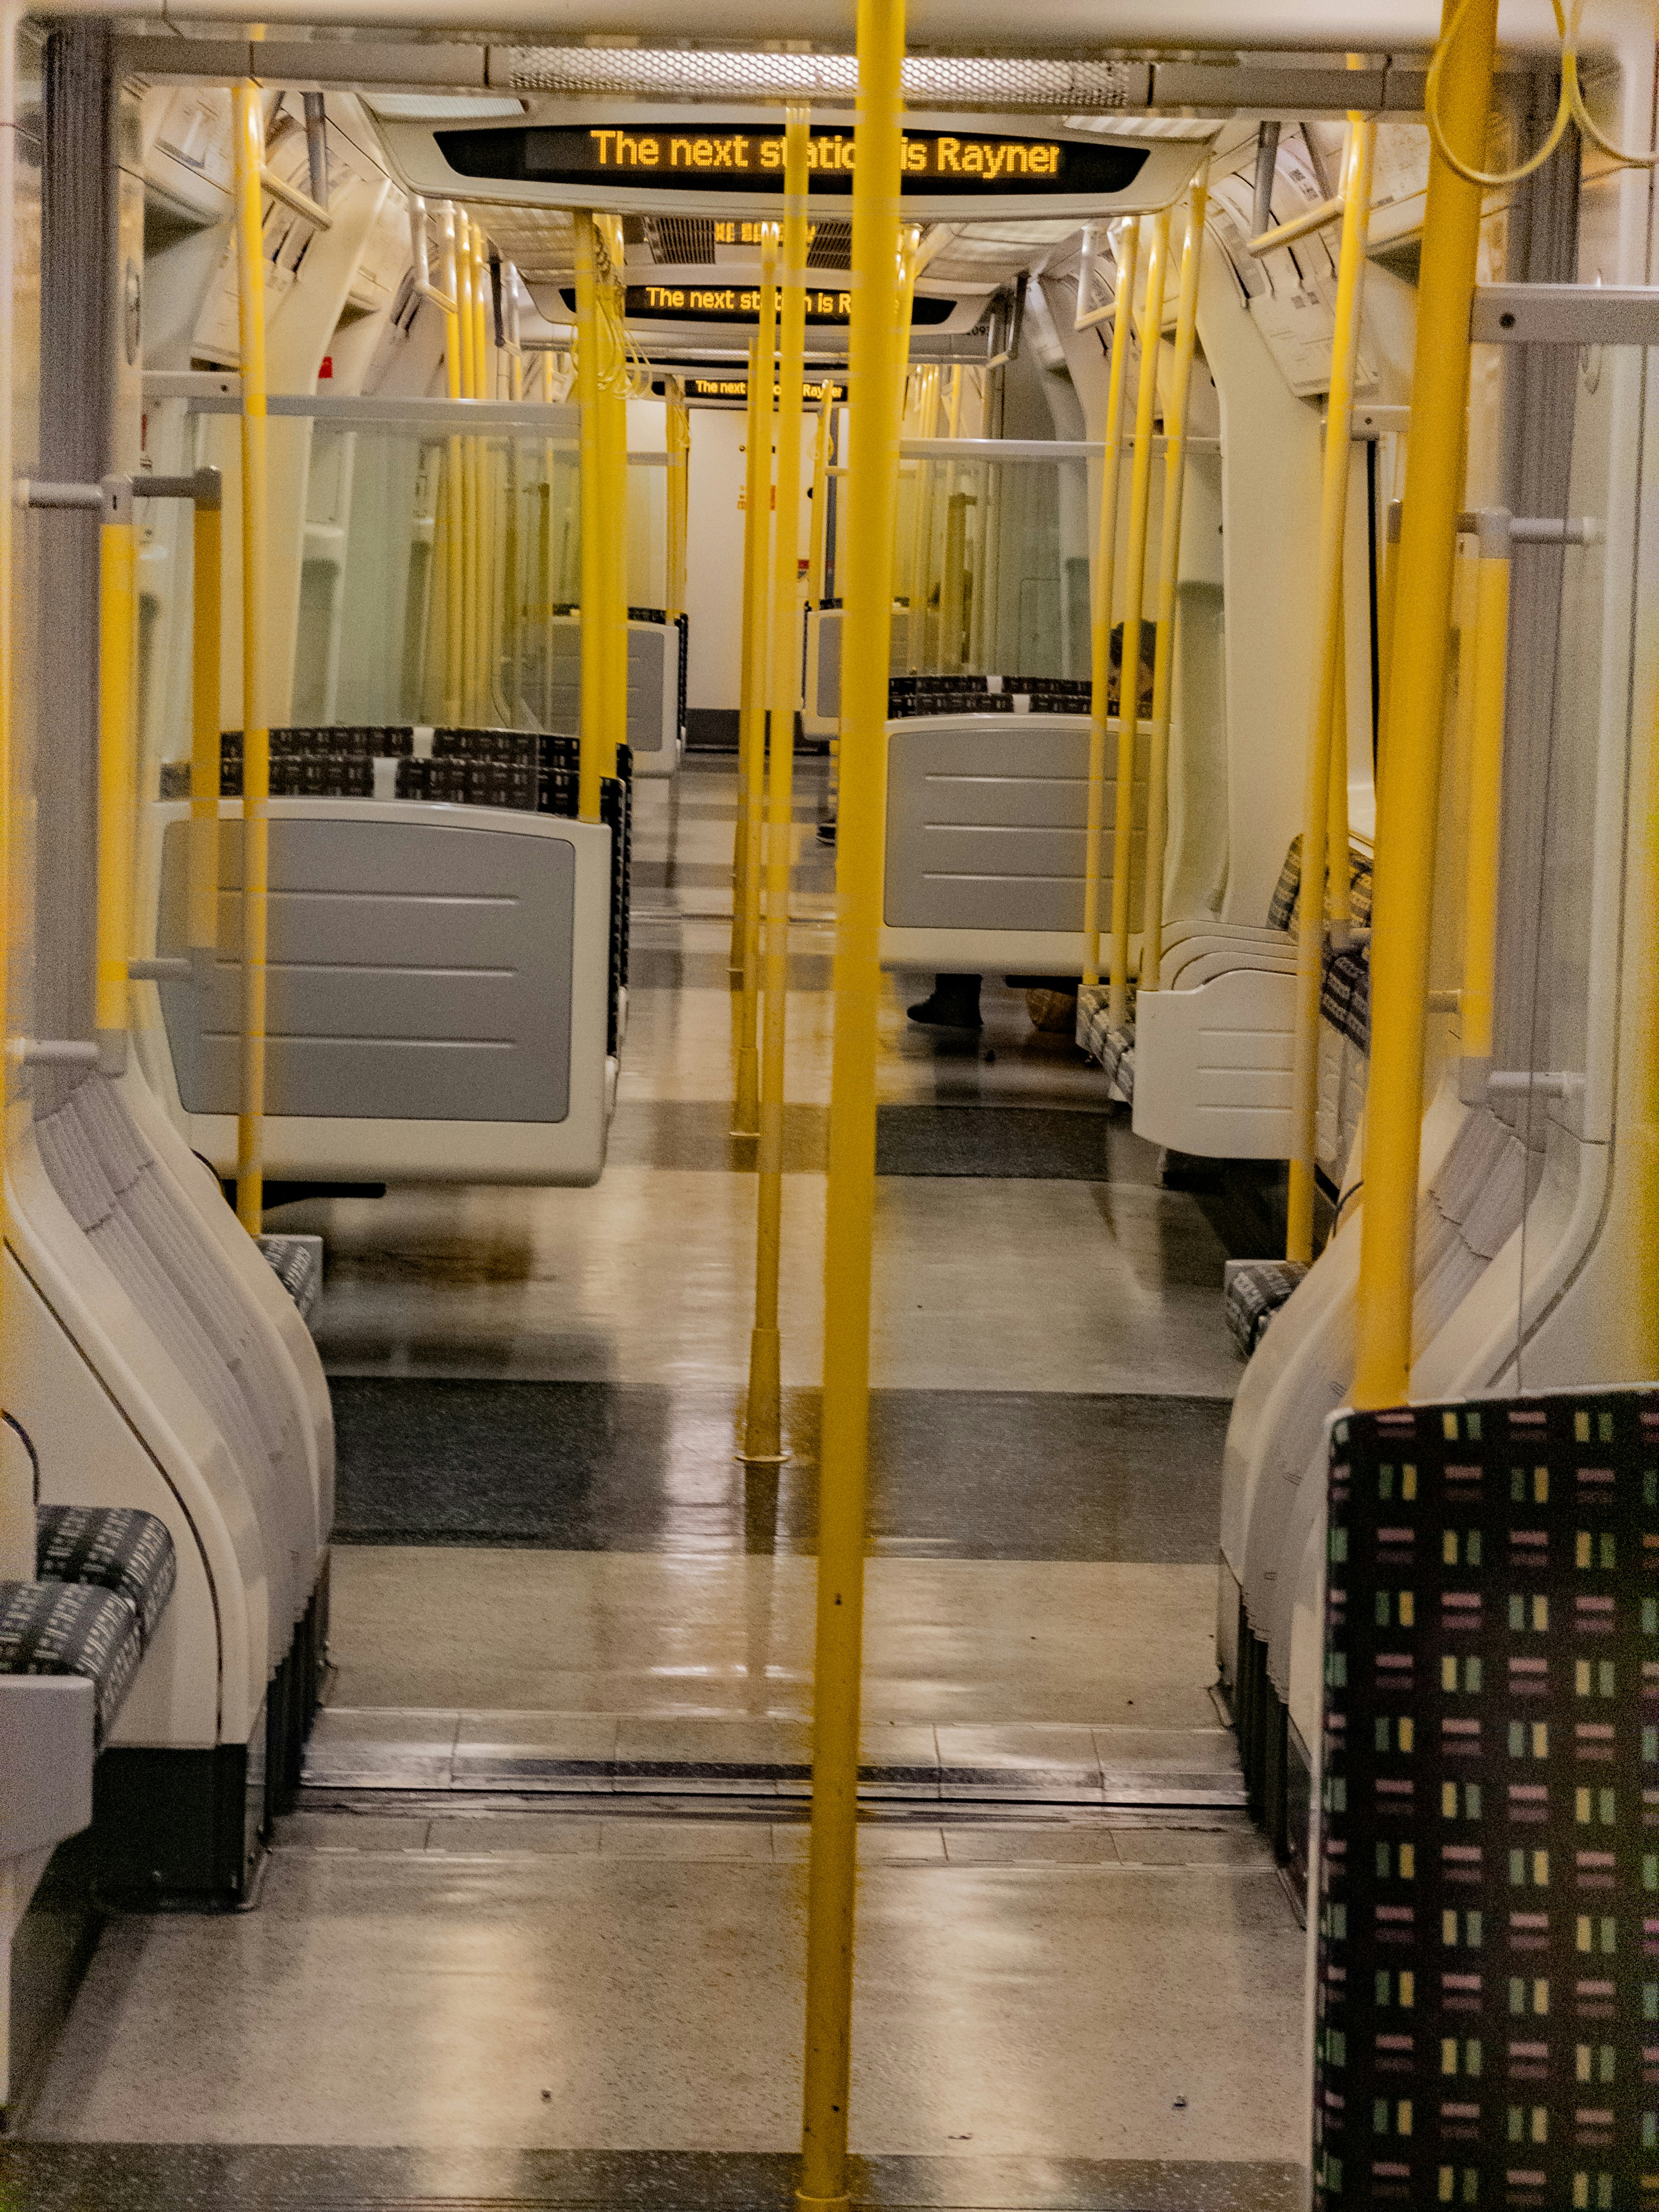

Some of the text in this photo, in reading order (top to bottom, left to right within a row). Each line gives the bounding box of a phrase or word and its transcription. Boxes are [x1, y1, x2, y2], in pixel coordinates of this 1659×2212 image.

[590, 129, 1060, 179] The next statio is Rayner
[646, 287, 685, 307] The
[690, 290, 735, 309] next
[739, 291, 812, 313] sttn
[817, 292, 833, 313] is
[696, 380, 843, 399] The next Rayer
